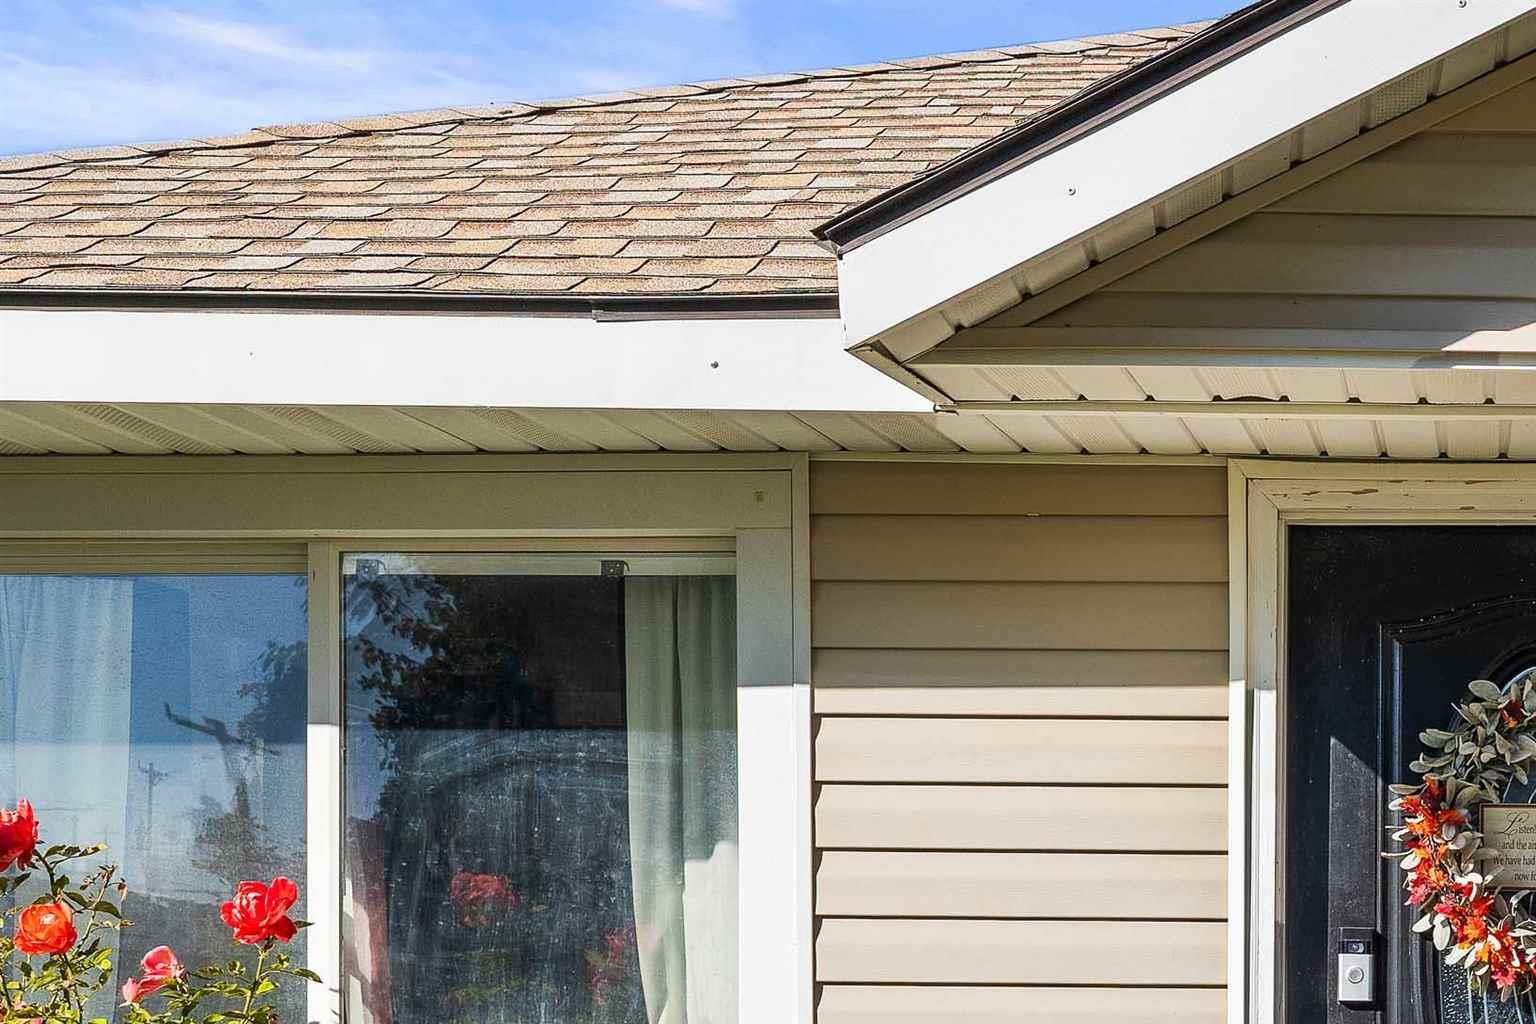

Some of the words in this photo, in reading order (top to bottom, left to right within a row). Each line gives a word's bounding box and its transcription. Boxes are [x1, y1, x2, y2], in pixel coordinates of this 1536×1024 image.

[1494, 811, 1536, 837] Listen!
[1501, 840, 1514, 849] and
[1516, 840, 1528, 849] the
[1528, 841, 1536, 849] air
[1492, 855, 1504, 865] We
[1505, 854, 1521, 865] have
[1522, 855, 1536, 865] had
[1513, 872, 1530, 881] now
